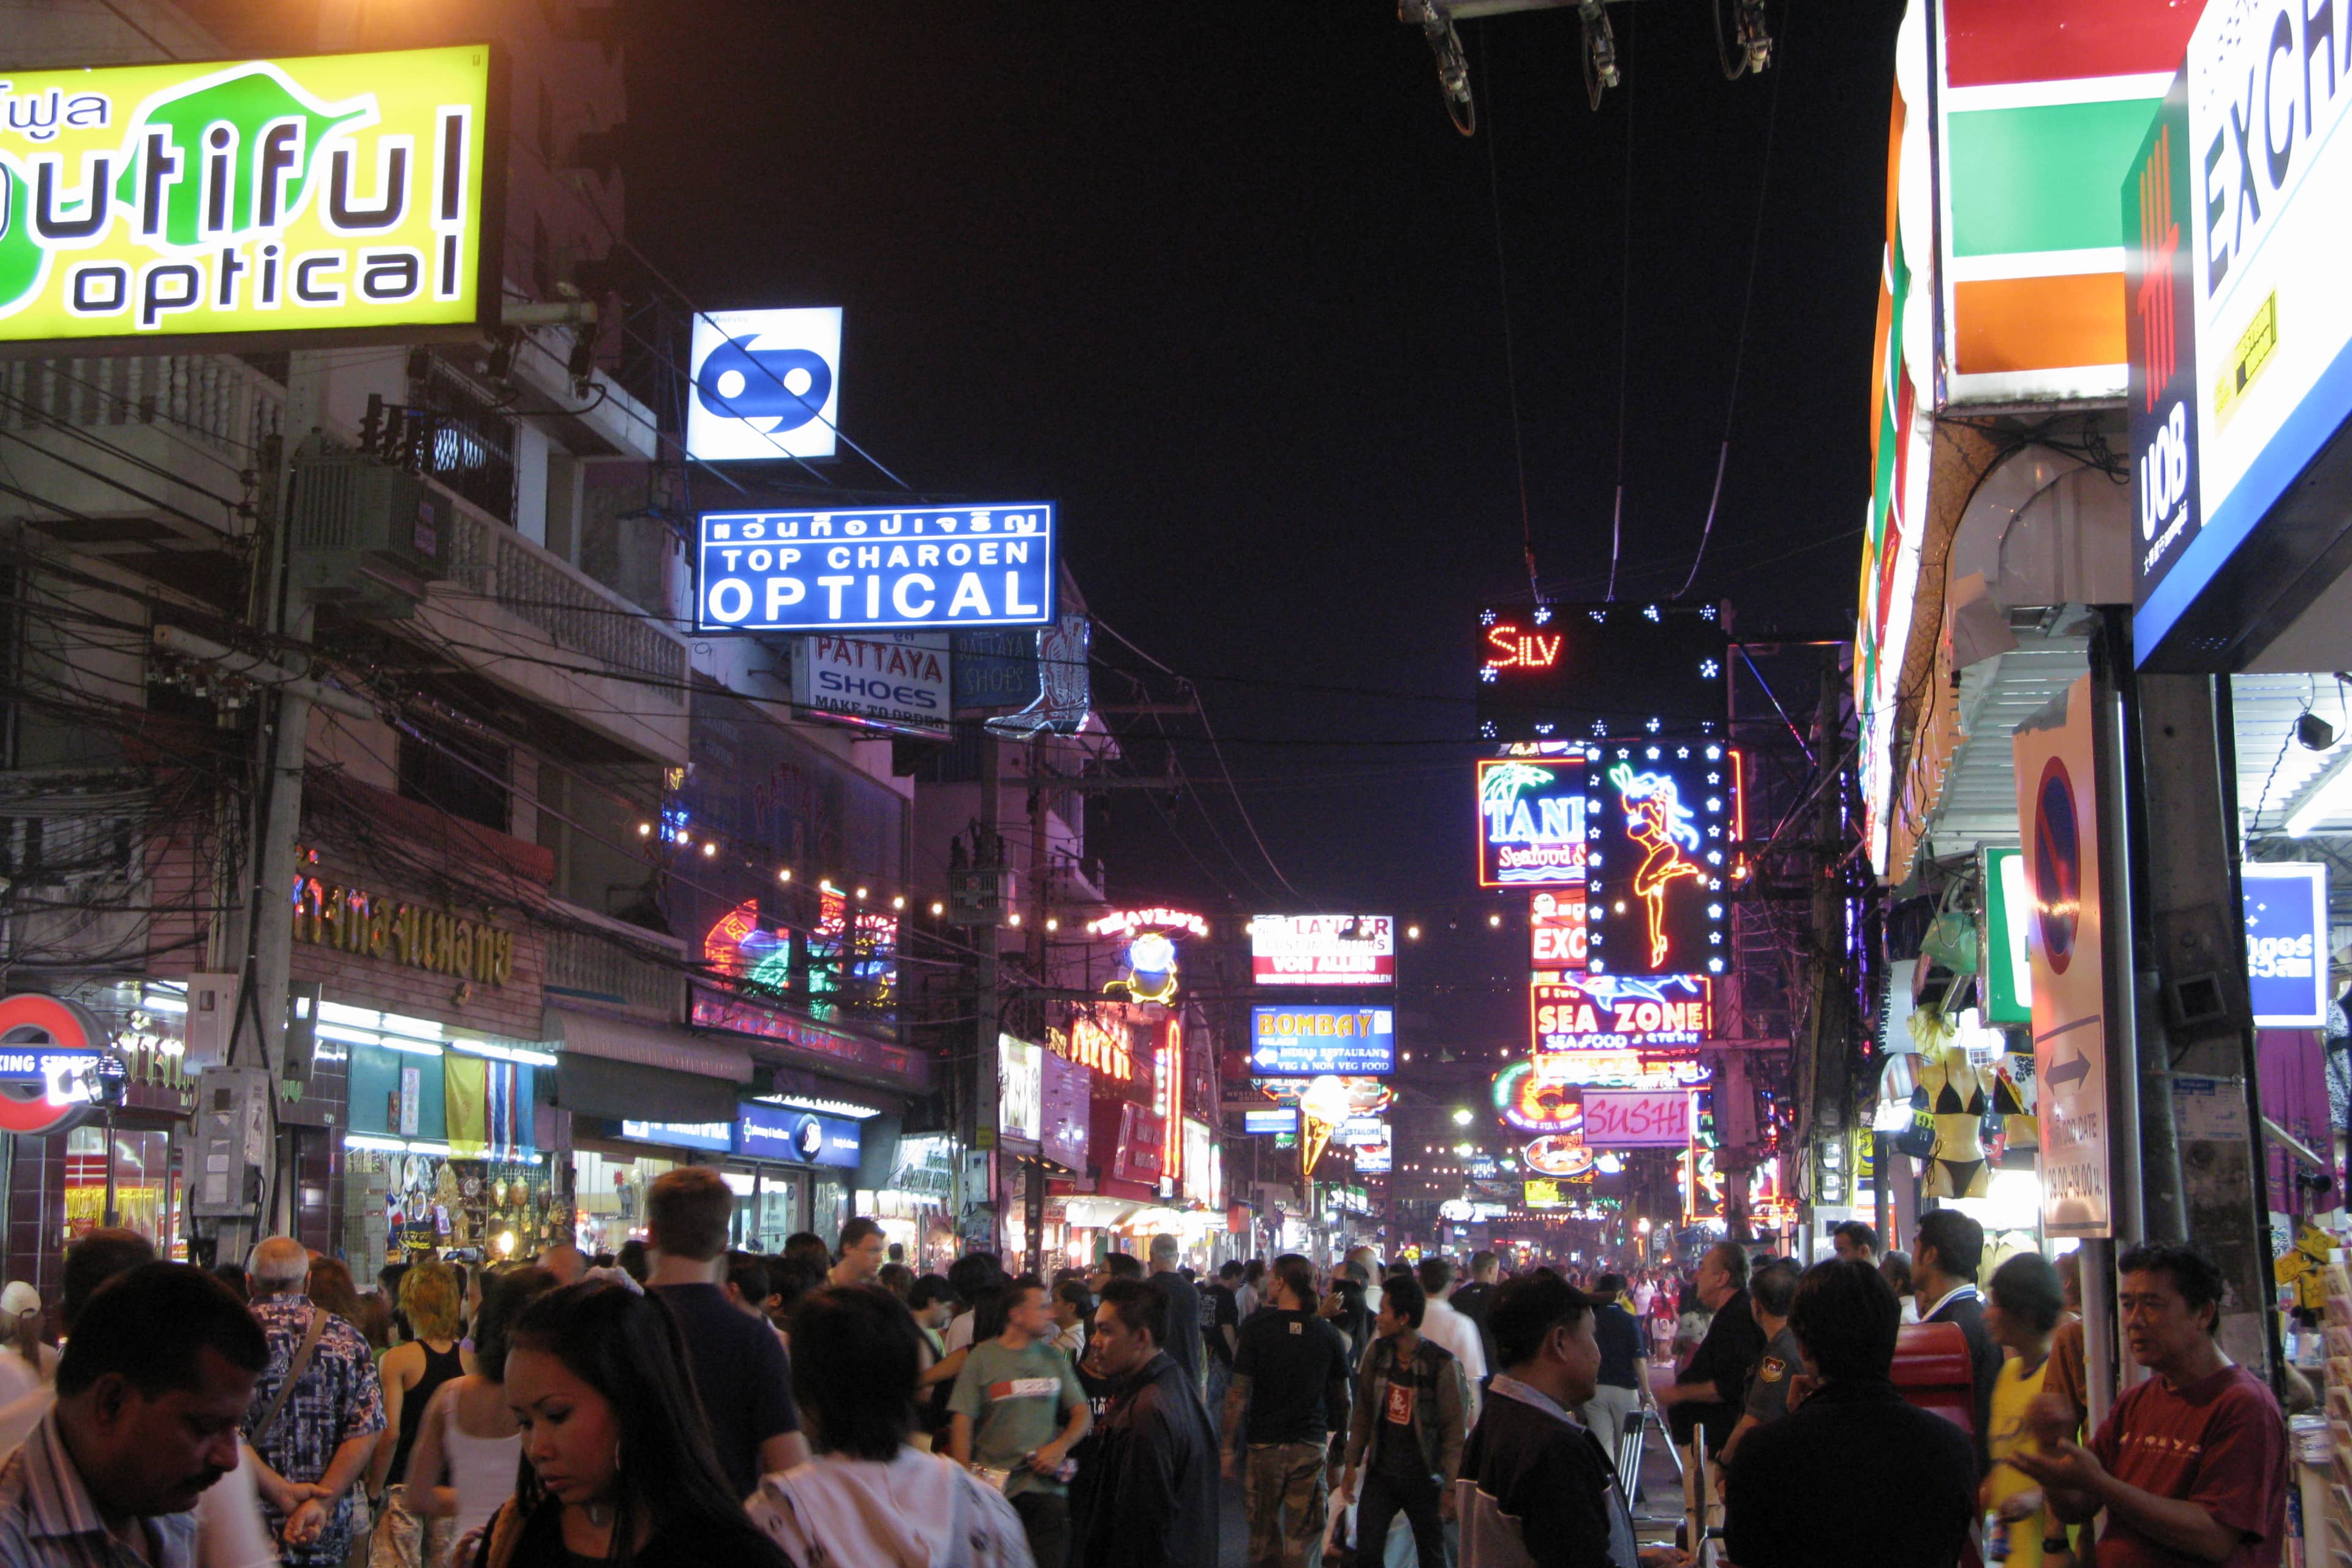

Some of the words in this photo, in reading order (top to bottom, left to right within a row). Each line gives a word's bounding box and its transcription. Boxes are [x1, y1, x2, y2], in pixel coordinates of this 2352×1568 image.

[0, 115, 463, 239] utiful
[73, 235, 457, 325] optical
[2141, 401, 2187, 541] UOB
[714, 511, 1037, 538] แว่นท็อปเจริญ
[722, 549, 802, 571] TOP
[827, 542, 1028, 570] CHAROEN
[709, 571, 1038, 622] OPTICAL
[815, 636, 943, 684] PATTAYA
[1489, 626, 1560, 667] SILV
[819, 671, 937, 709] SHOES
[814, 695, 861, 714] MAKE
[867, 705, 888, 718] TO
[1499, 845, 1570, 867] Seafood
[1534, 927, 1586, 959] EXC
[1272, 956, 1314, 972] VON
[1257, 1014, 1373, 1038] BOMBAY
[1539, 1004, 1599, 1034] SEA
[1614, 1003, 1704, 1032] ZONE
[1280, 1048, 1317, 1057] INDIAN
[1320, 1048, 1386, 1057] RESTAURANT
[1546, 1034, 1627, 1050] SEAFOOD
[1362, 1061, 1389, 1071] FOOD
[1585, 1099, 1688, 1135] SUSHI
[2078, 1112, 2097, 1140] DATE
[2048, 1163, 2092, 1199] 09.00-19.00
